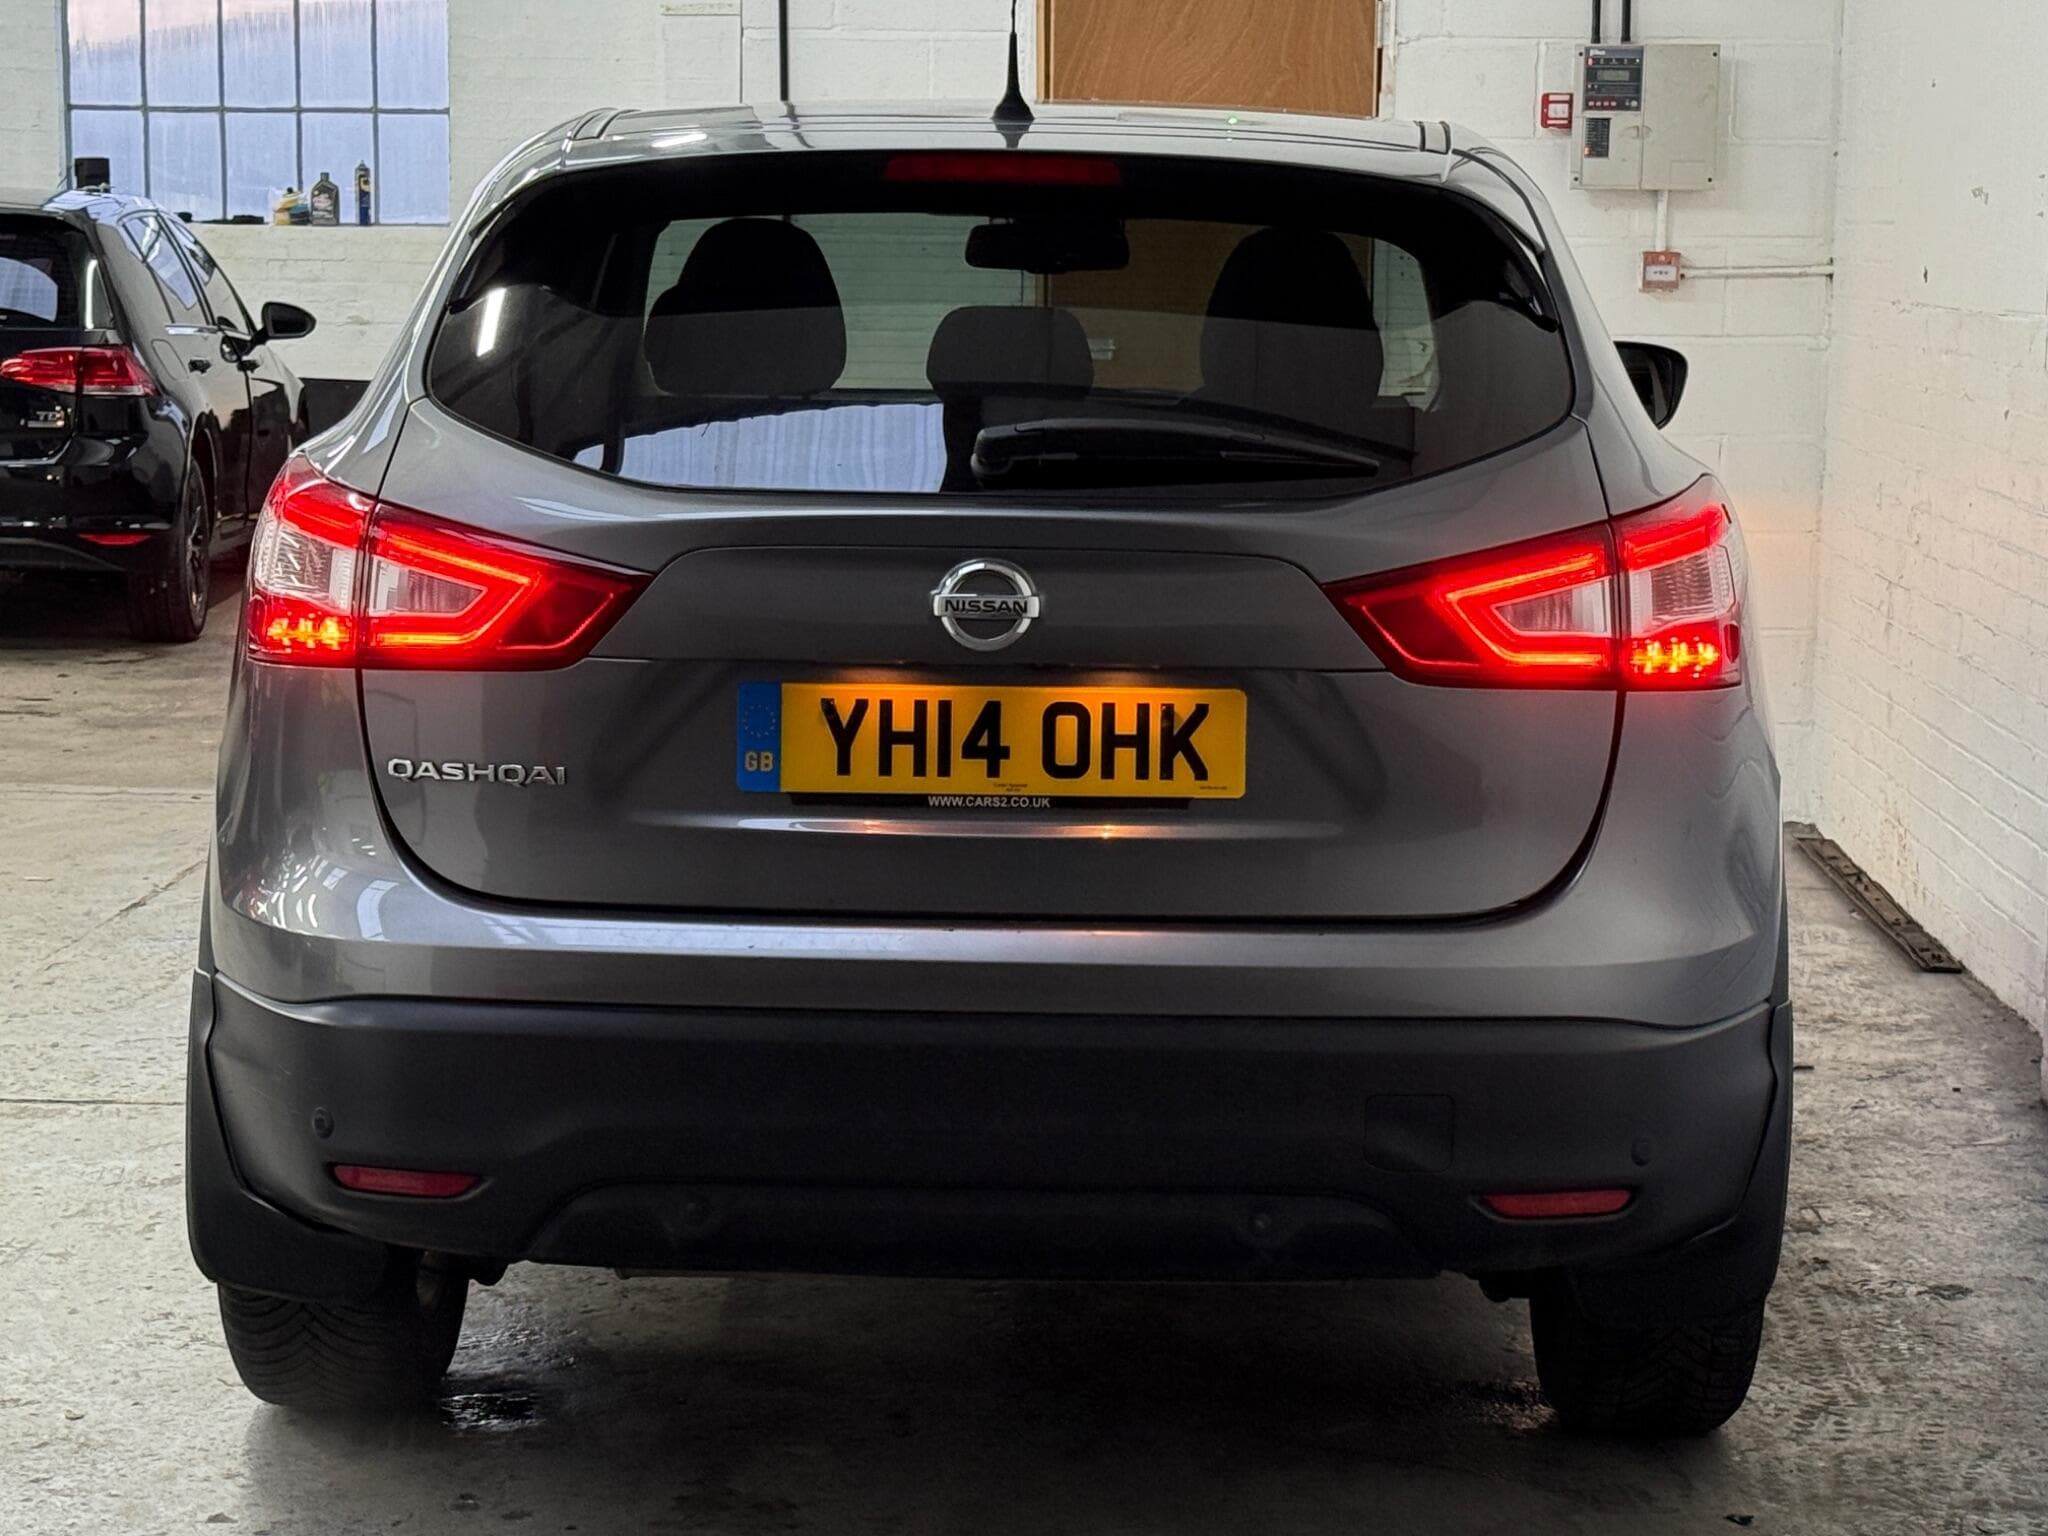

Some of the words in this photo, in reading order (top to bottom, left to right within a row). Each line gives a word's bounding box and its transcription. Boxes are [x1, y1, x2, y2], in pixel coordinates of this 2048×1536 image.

[944, 599, 1028, 615] NISSAN
[820, 698, 1011, 778] YH14
[1042, 701, 1210, 781] OHK
[745, 751, 774, 771] GB
[387, 758, 566, 787] QASHQAI
[927, 795, 1051, 808] WWW.CARS2.CO.UK
